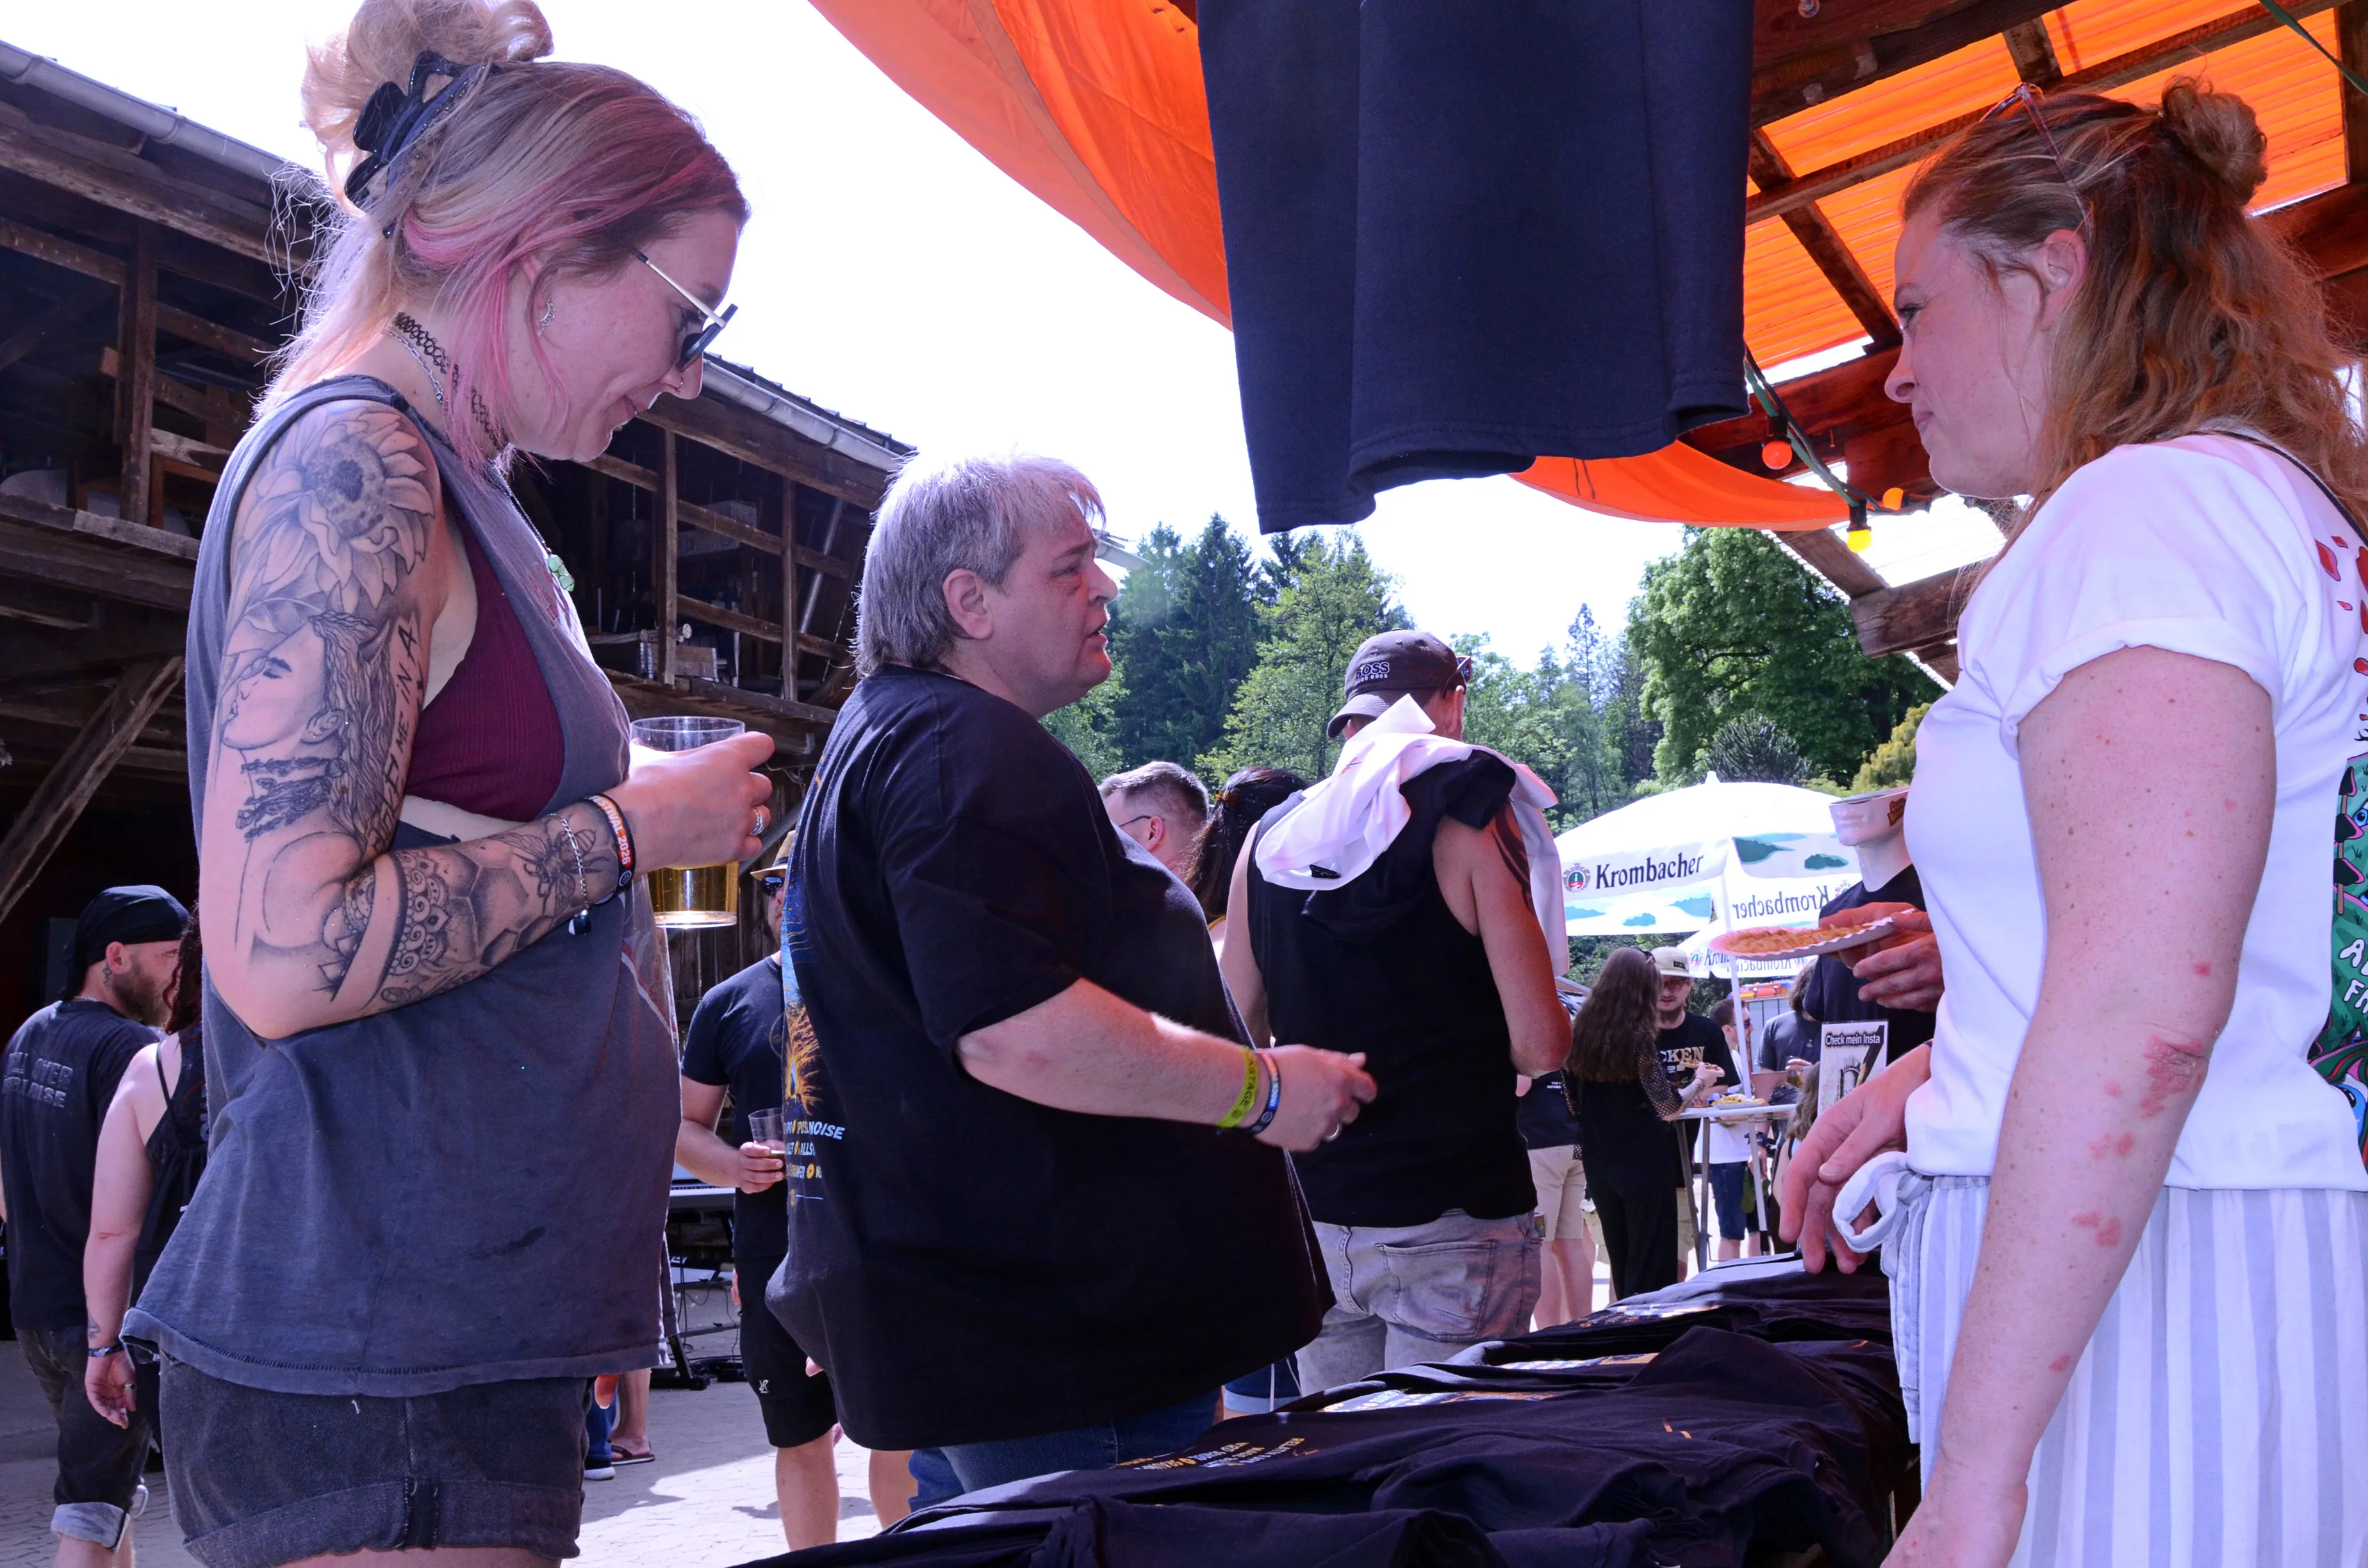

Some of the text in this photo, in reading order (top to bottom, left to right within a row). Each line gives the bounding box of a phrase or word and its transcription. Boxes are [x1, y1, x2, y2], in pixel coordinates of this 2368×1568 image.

[617, 835, 631, 865] 2026
[1596, 853, 1704, 889] Krombacher
[1825, 1033, 1880, 1045] Check mein Insta
